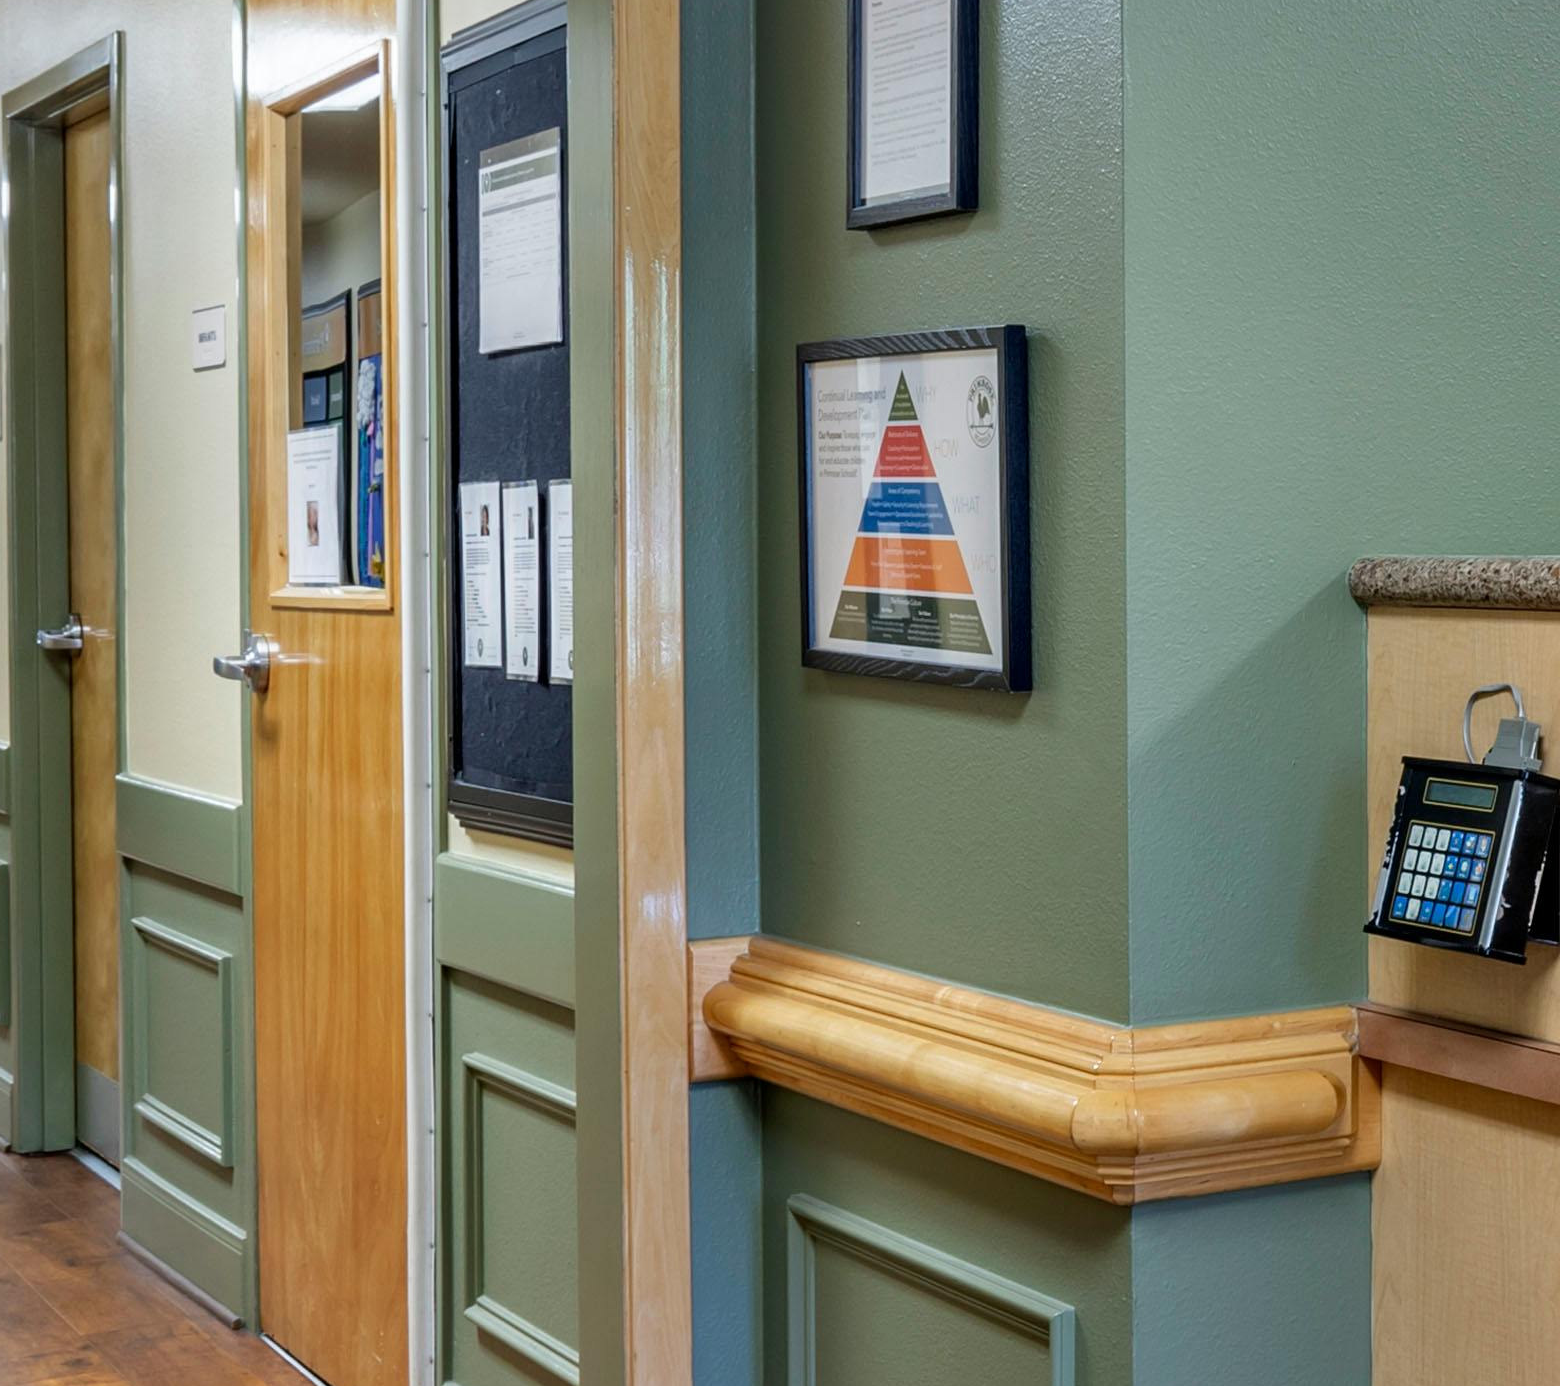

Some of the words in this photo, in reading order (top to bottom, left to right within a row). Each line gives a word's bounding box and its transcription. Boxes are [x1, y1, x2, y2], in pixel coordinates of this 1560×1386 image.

[818, 389, 845, 403] Continual
[847, 389, 873, 404] Learning
[874, 387, 886, 400] and
[818, 408, 858, 424] Development
[934, 438, 959, 458] HOW
[952, 495, 981, 514] WHAT
